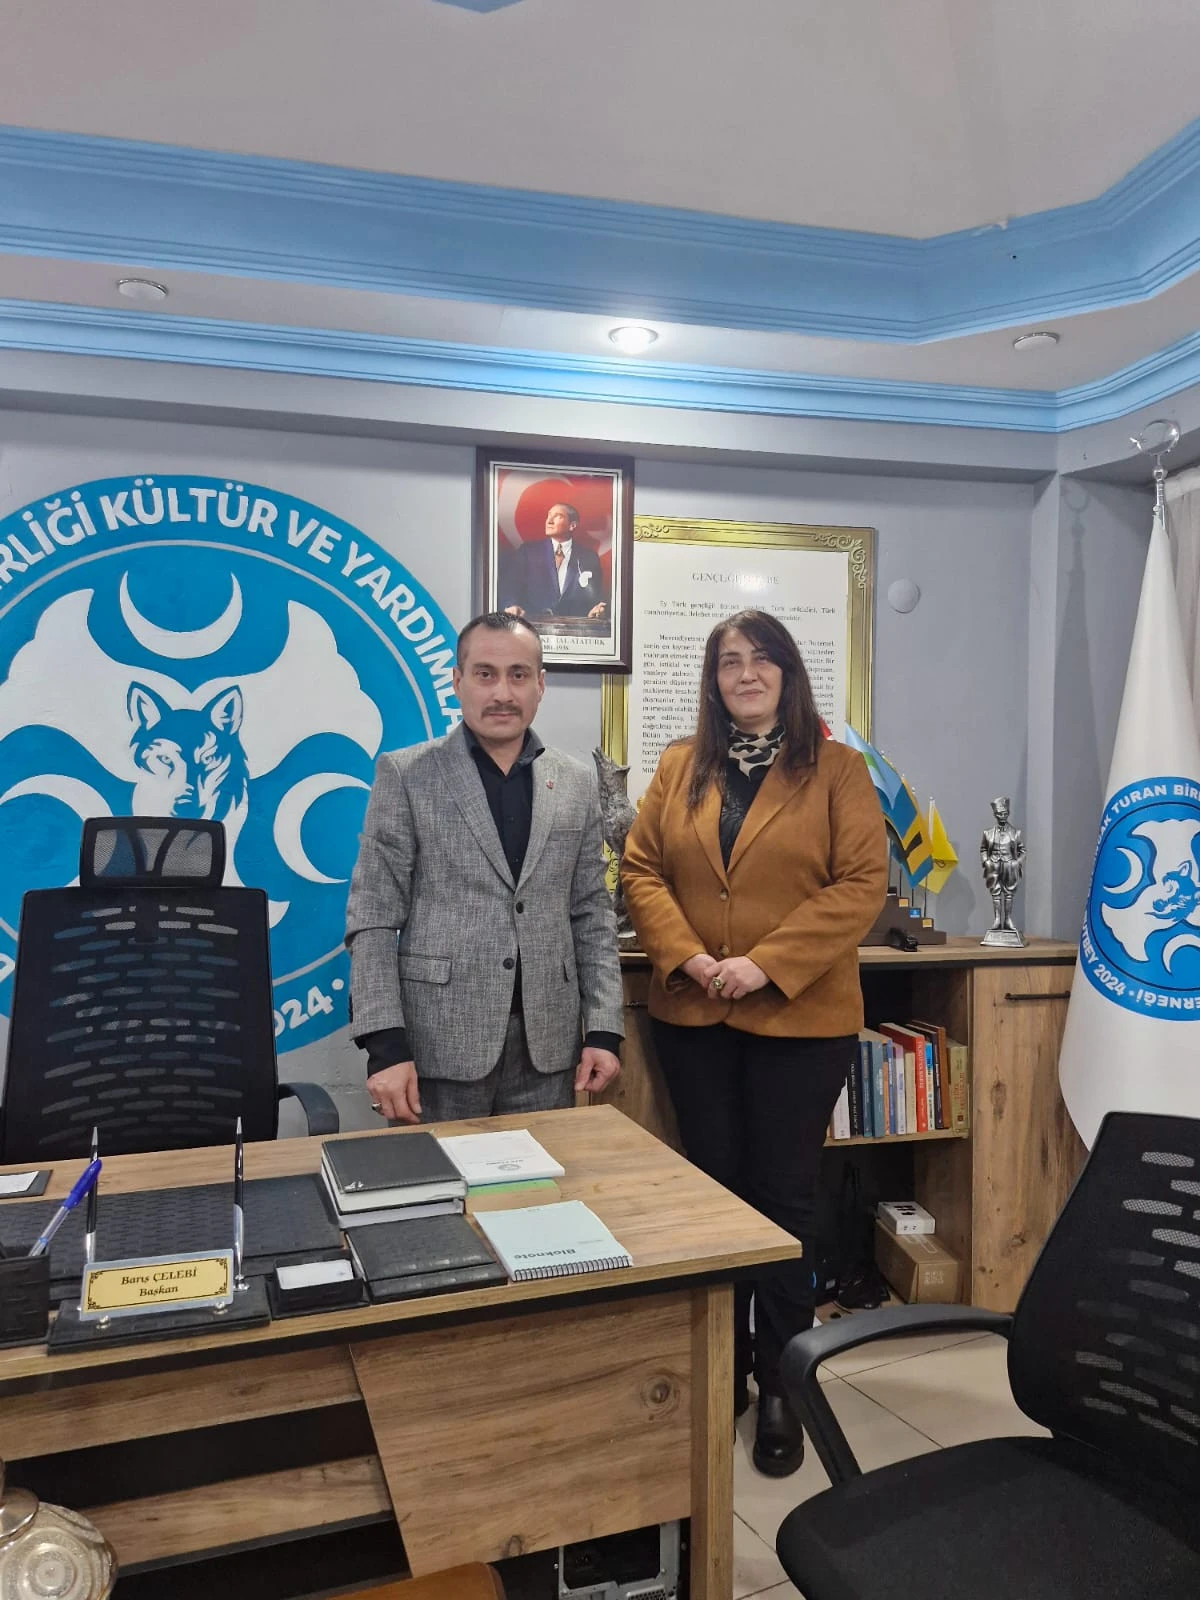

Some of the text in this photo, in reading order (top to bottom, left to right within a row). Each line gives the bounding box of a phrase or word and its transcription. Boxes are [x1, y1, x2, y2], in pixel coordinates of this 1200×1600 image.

[0, 491, 97, 590] RLİĞİ
[100, 478, 278, 538] KÜLTÜR
[287, 509, 343, 565] VE
[1111, 784, 1168, 815] TURAN
[1093, 964, 1126, 996] 2024
[513, 1247, 577, 1262] Bloknote
[121, 1265, 198, 1286] Barış ÇELEBİ
[139, 1284, 179, 1298] Başkan
